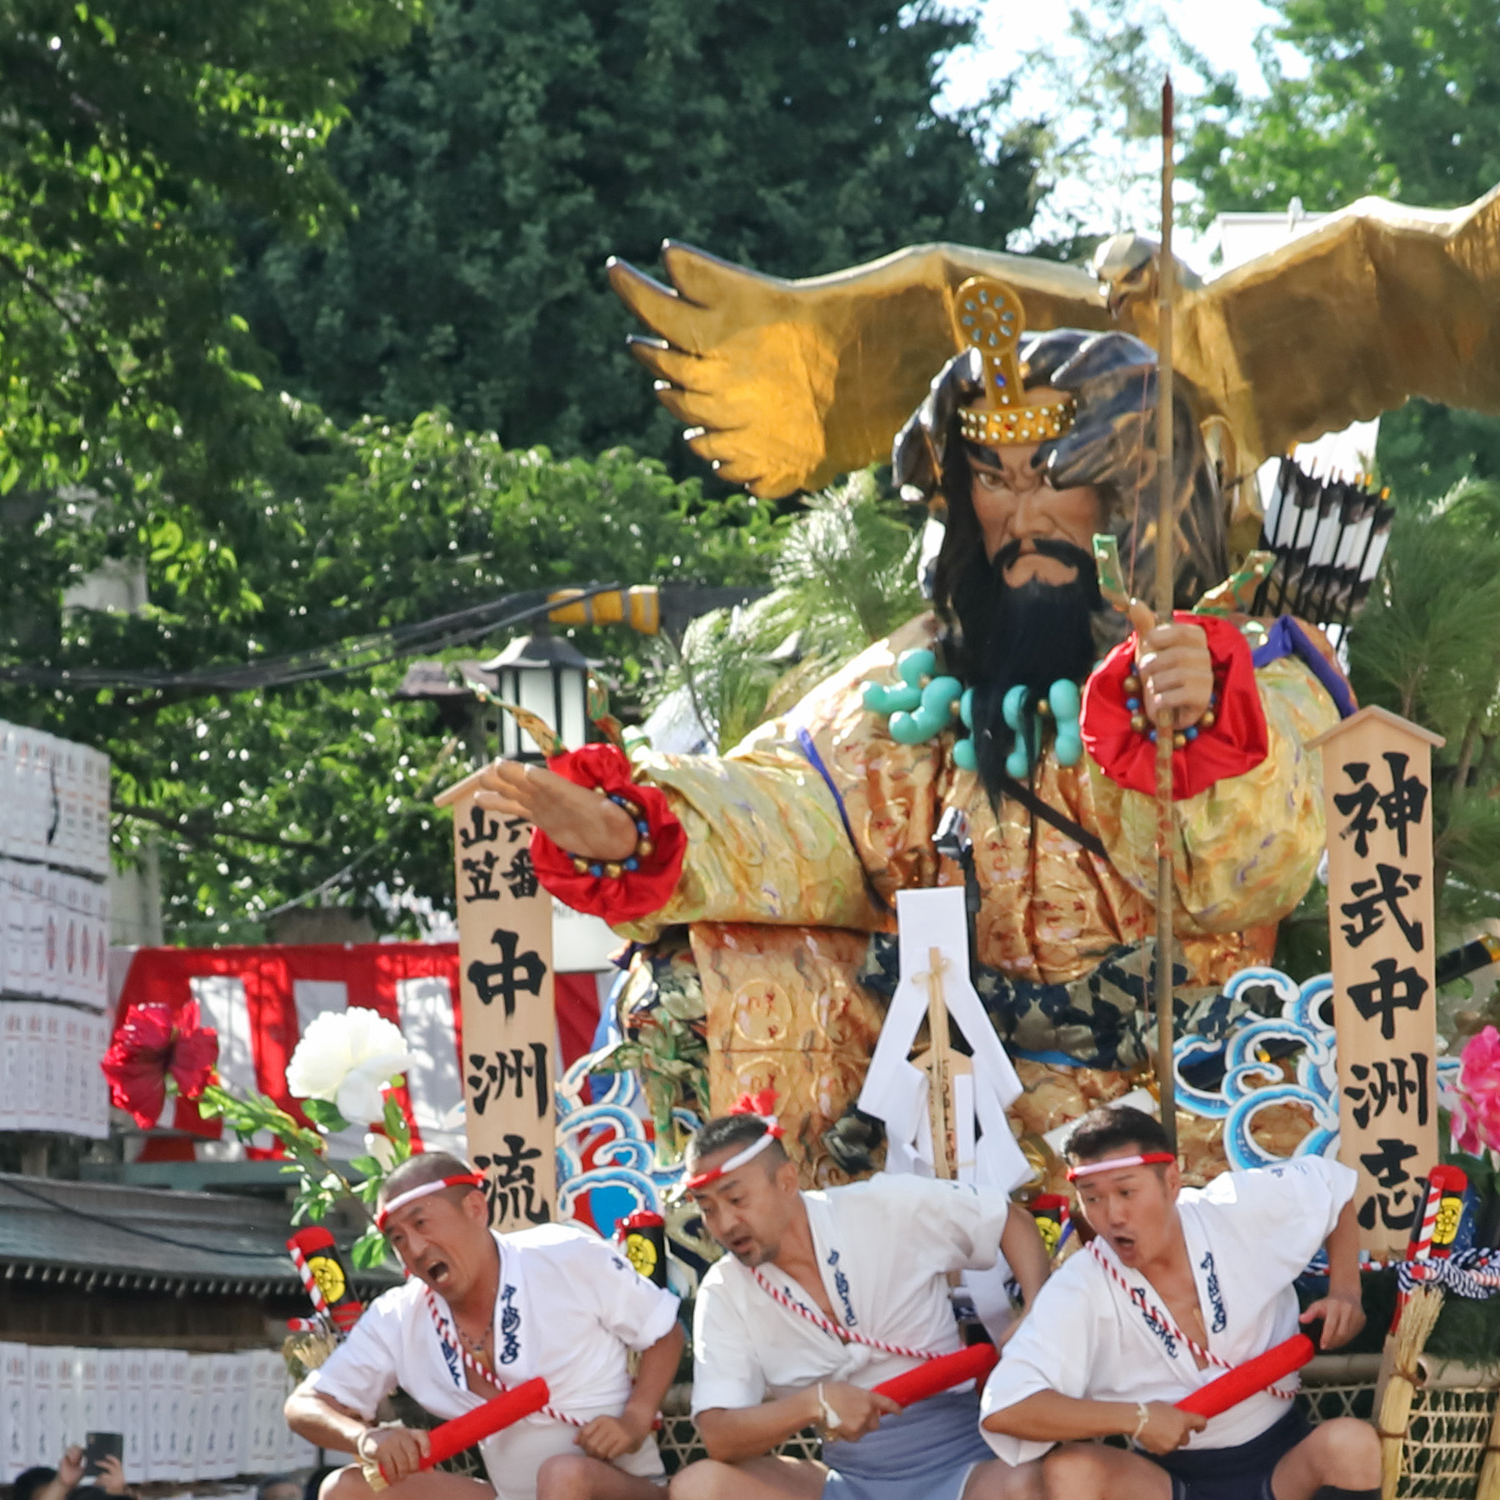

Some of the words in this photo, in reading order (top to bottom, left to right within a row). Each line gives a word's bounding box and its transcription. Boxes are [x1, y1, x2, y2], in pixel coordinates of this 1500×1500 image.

[459, 805, 501, 903] 山笠
[1332, 751, 1430, 1231] 神武中洲志
[467, 927, 551, 1228] 中洲流
